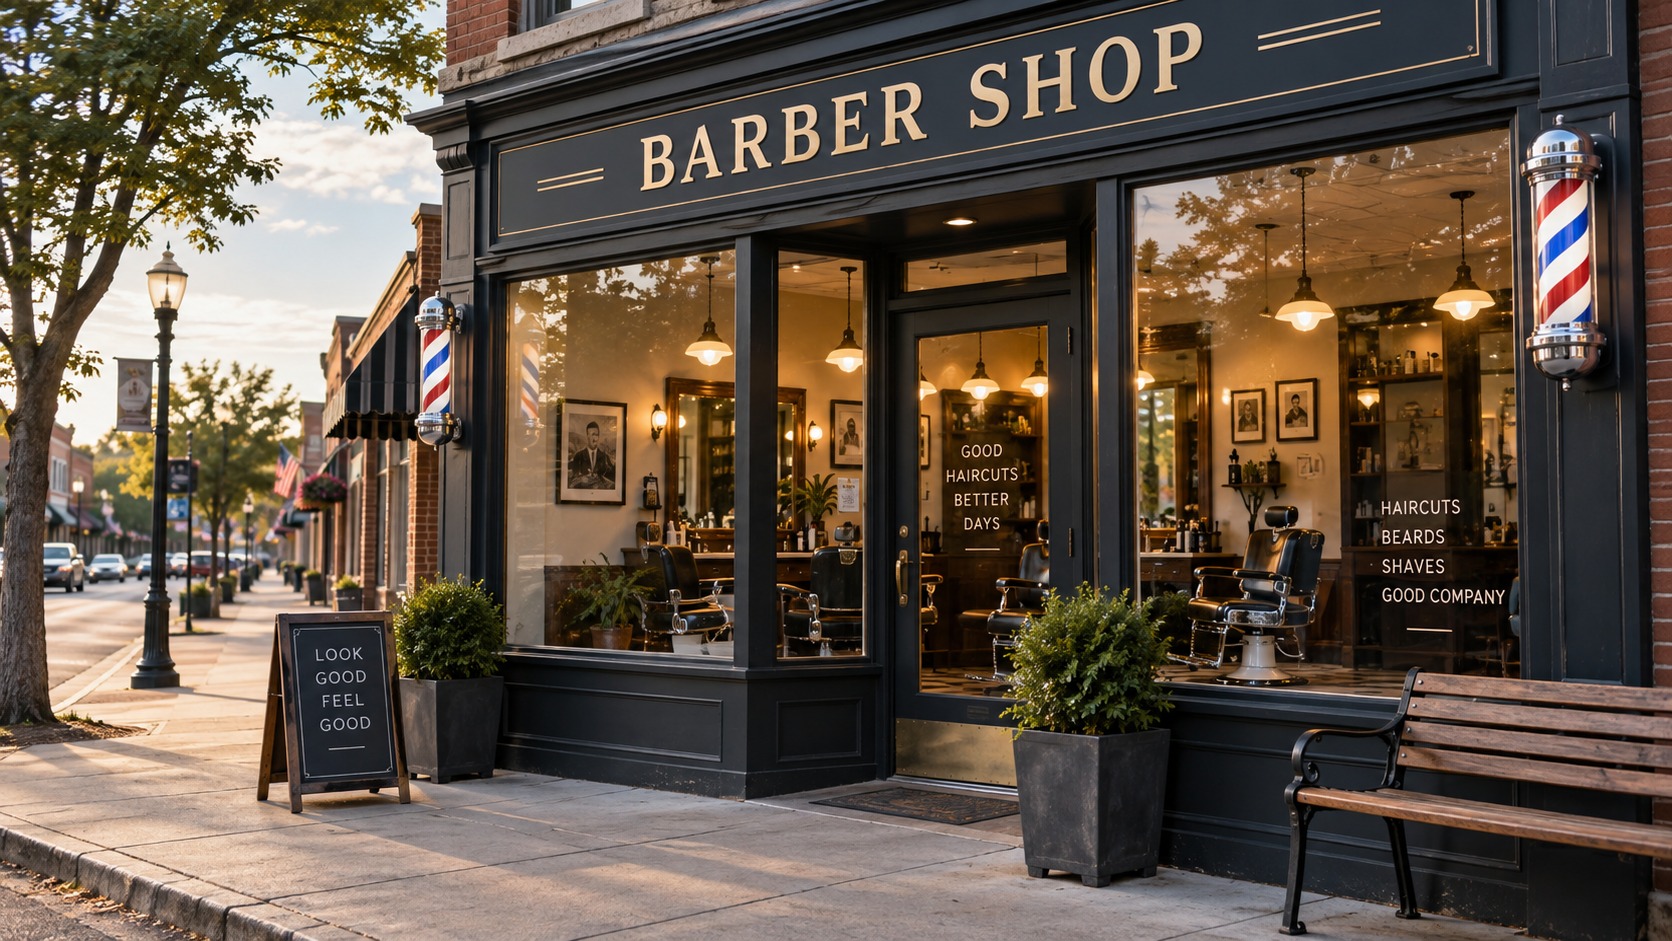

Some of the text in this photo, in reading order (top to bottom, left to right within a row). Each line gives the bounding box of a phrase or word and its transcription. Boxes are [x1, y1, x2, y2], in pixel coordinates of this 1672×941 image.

[640, 22, 1203, 191] BARBER SHOP
[961, 443, 1003, 458] GOOD
[946, 467, 1018, 483] HAIRCUTS
[954, 492, 1009, 507] BETTER
[1381, 499, 1461, 515] HAIRCUTS
[964, 516, 1000, 530] DAYS
[1382, 529, 1445, 545] BEARDS
[1382, 558, 1445, 574] SHAVES
[1382, 587, 1506, 605] GOOD COMPANY
[315, 646, 363, 662] LOOK
[315, 670, 367, 685] GOOD
[322, 693, 365, 708] FEEL
[319, 716, 371, 732] GOOD
